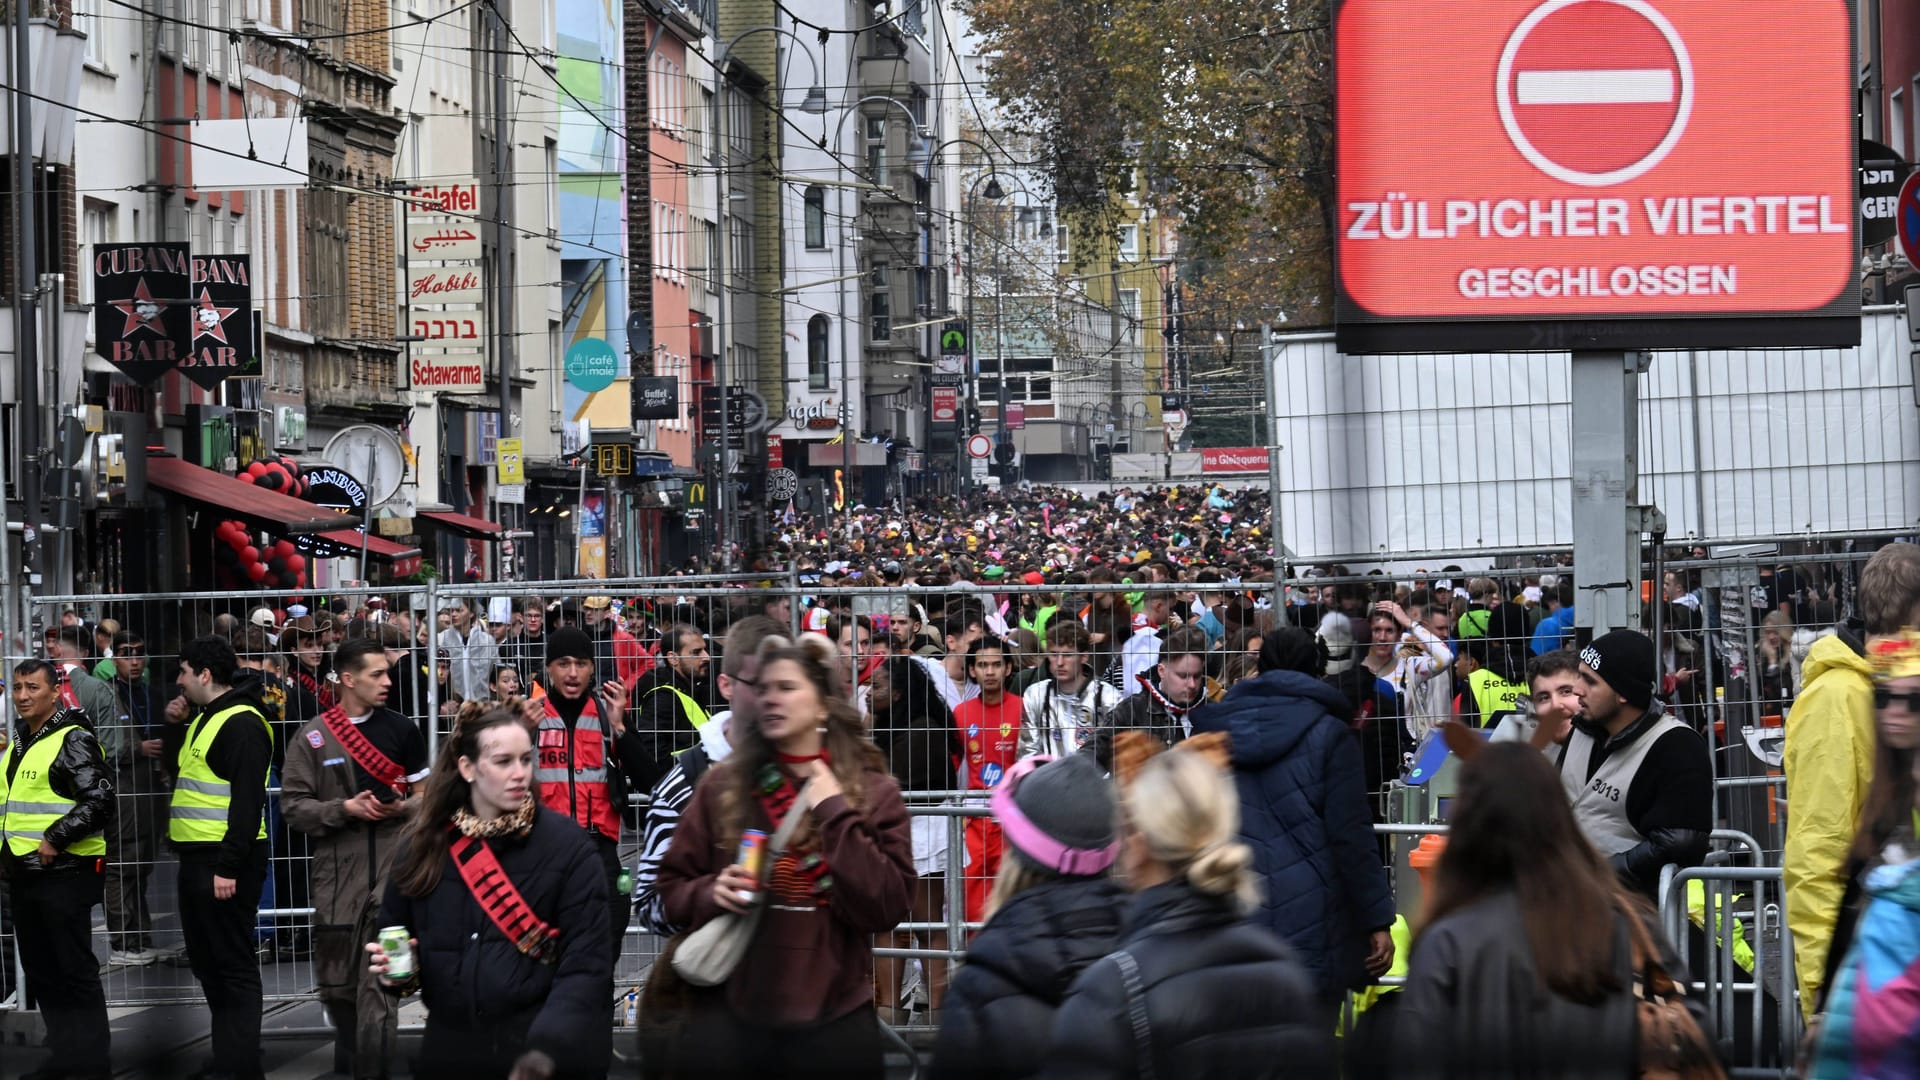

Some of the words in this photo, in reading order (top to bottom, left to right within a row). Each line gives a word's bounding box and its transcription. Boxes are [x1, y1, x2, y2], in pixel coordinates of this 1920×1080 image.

[410, 184, 476, 211] Falafel
[1347, 193, 1630, 240] ZÜLPICHER
[1644, 195, 1848, 236] VIERTEL
[412, 228, 478, 253] حبيبي
[95, 247, 189, 278] CUBANA
[411, 271, 478, 298] Habibi
[1458, 265, 1737, 298] GESCHLOSSEN
[414, 319, 478, 340] ברכה
[112, 339, 176, 361] BAR
[177, 346, 239, 368] BAR
[589, 354, 614, 365] café
[412, 359, 481, 386] Schawarma
[589, 366, 615, 376] malé
[644, 388, 668, 399] Gaffel
[1499, 692, 1523, 703] 48
[539, 751, 568, 765] 168
[20, 769, 37, 780] 113
[982, 762, 1002, 787] hp
[1591, 778, 1621, 802] 3013
